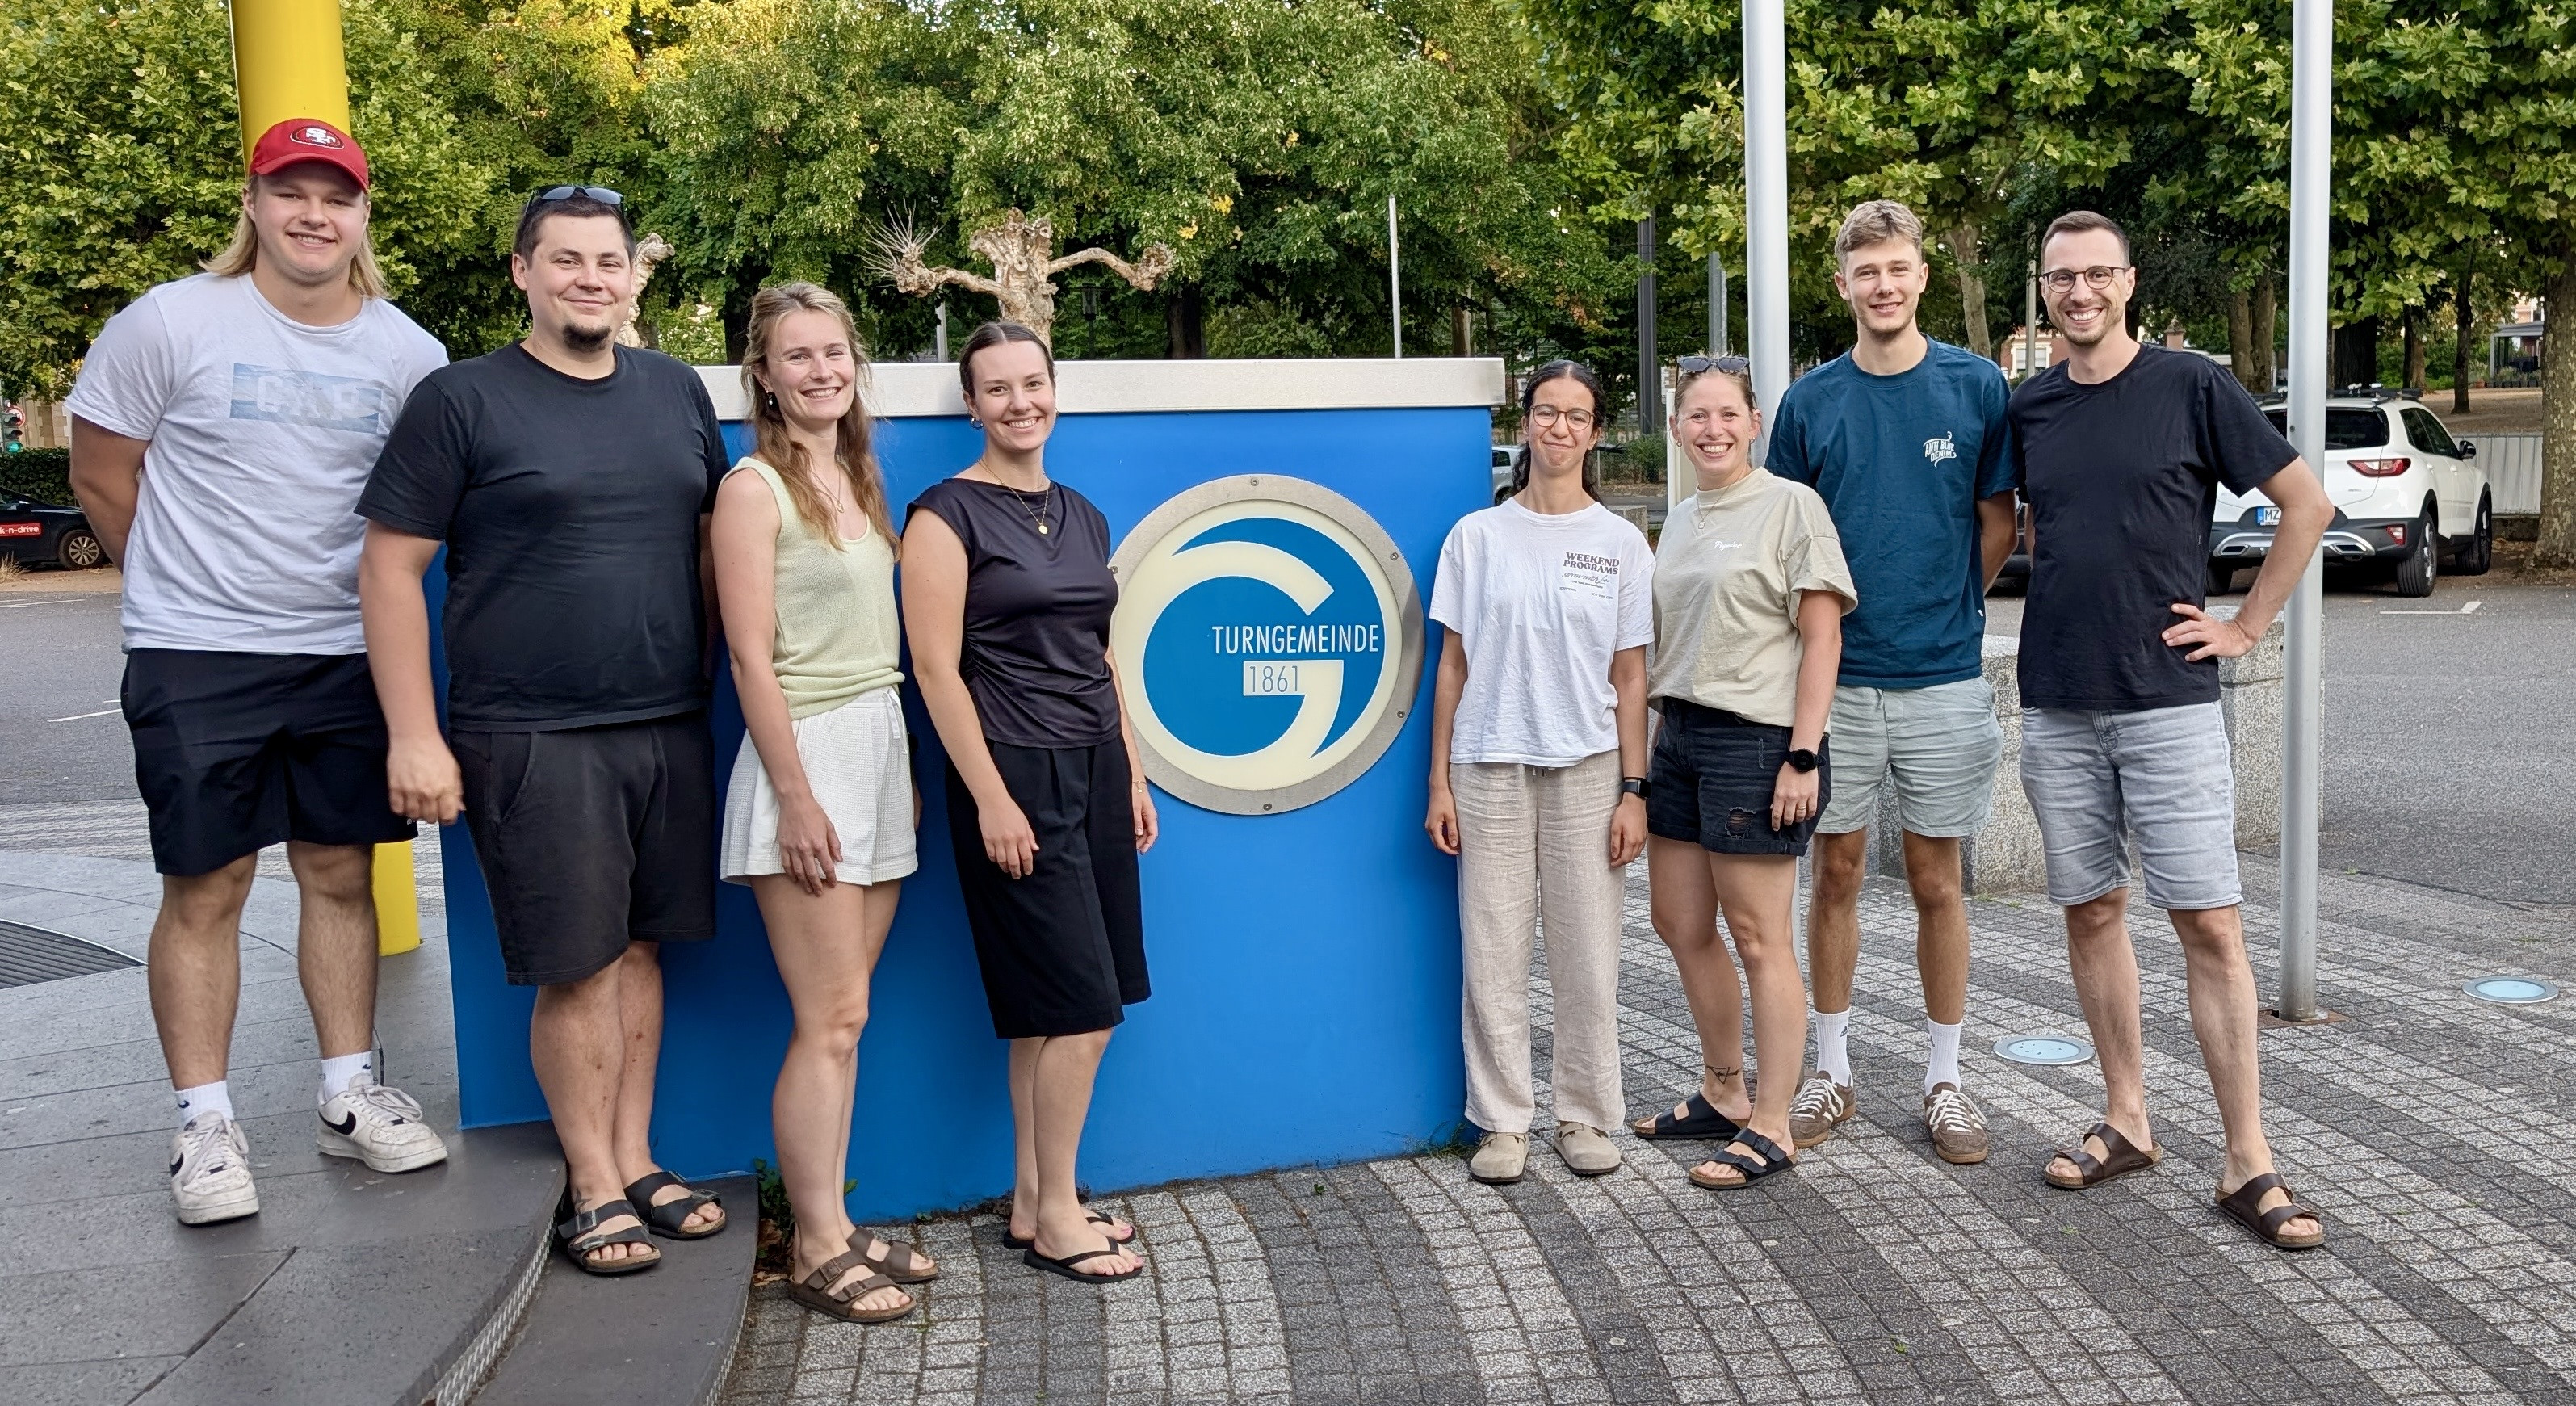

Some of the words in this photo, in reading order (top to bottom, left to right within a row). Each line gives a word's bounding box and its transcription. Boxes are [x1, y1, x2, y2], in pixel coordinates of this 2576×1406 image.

[1925, 441, 1939, 458] ANTI
[1940, 440, 1955, 452] BLUE
[1931, 450, 1953, 463] DENIM
[2265, 509, 2280, 521] MZ
[1566, 552, 1620, 567] WEEKEND
[1563, 560, 1619, 575] PROGRAMS
[1211, 624, 1379, 654] TURNGEMEINDE
[1249, 665, 1299, 693] 1861
